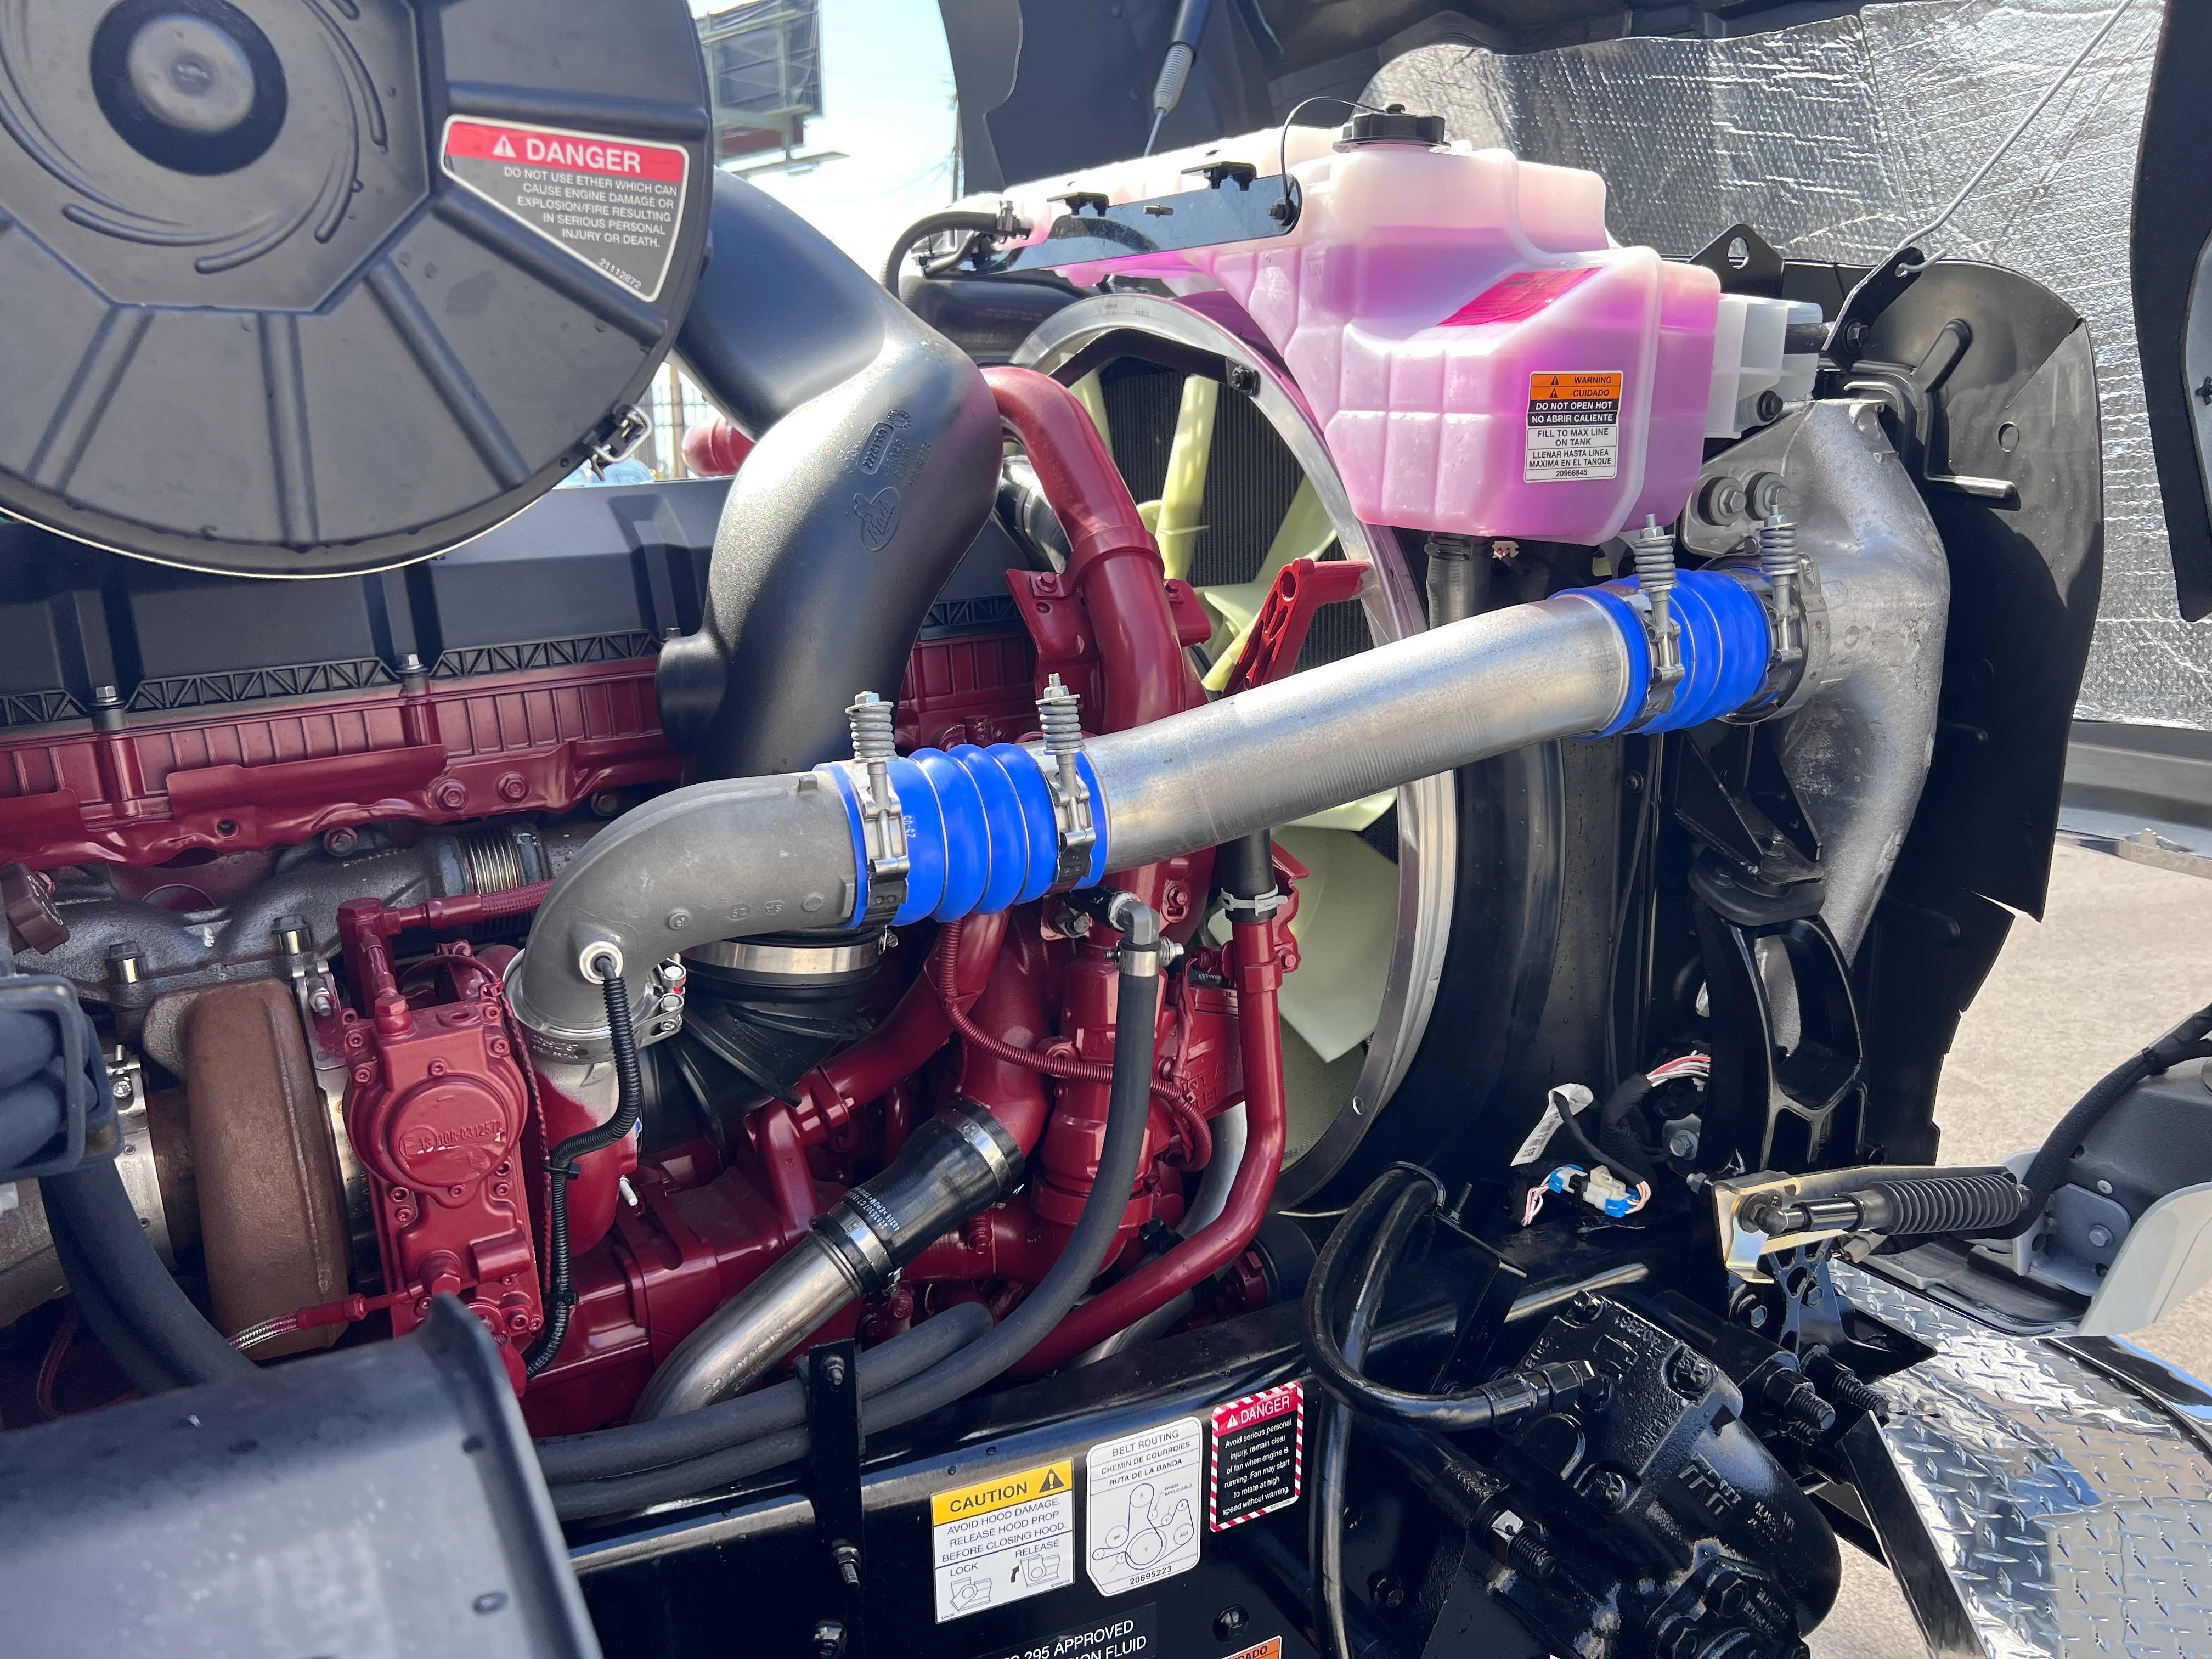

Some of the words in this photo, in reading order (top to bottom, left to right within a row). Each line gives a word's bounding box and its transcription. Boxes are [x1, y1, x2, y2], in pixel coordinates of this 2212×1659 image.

[526, 138, 641, 173] DANGER
[504, 167, 521, 178] DO
[524, 168, 548, 181] NOT
[551, 172, 572, 184] USE
[577, 175, 612, 189] ETHER
[616, 180, 652, 193] WHICH
[655, 184, 677, 195] CAN
[517, 196, 609, 214] EXPLOSION/FIRE
[613, 207, 671, 222] RESULTING
[523, 183, 561, 197] CAUSE
[565, 188, 606, 201] ENGINE
[609, 193, 656, 207] DAMAGE
[658, 199, 674, 209] OR
[543, 213, 554, 223] IN
[557, 216, 606, 229] SERIOUS
[608, 222, 665, 235] PERSONAL
[562, 228, 601, 241] INJURY
[604, 234, 620, 242] OR
[623, 235, 660, 247] DEATH.
[599, 258, 642, 290] 21112872
[1574, 414, 1612, 422] CALIENTE
[1240, 1396, 1290, 1424] DANGER
[1113, 1443, 1136, 1457] BELT
[1138, 1430, 1178, 1448] ROUTING
[1225, 1436, 1242, 1448] Avoid
[1244, 1430, 1265, 1441] serious
[1267, 1419, 1292, 1435] personal
[1231, 1449, 1248, 1460] injury,
[1250, 1441, 1269, 1453] remain
[1271, 1434, 1286, 1443] clear
[1102, 1460, 1131, 1475] CHEMIN
[1133, 1456, 1143, 1465] DE
[1146, 1442, 1190, 1460] COURROIES
[1109, 1475, 1130, 1486] RUTA
[1132, 1471, 1142, 1480] DE
[1144, 1468, 1154, 1476] LA
[1156, 1458, 1182, 1472] BANDA
[1234, 1464, 1244, 1472] fan
[1245, 1458, 1261, 1468] when
[1262, 1450, 1282, 1462] engine
[1224, 1475, 1249, 1488] running.
[1250, 1471, 1261, 1480] Fan
[1263, 1466, 1275, 1476] may
[1277, 1459, 1290, 1469] start
[1242, 1483, 1259, 1495] rotate
[1267, 1476, 1279, 1487] high
[950, 1482, 1028, 1513] CAUTION
[1165, 1483, 1193, 1496] APPLICABLE
[1223, 1502, 1241, 1515] speed
[1243, 1495, 1263, 1508] without
[1265, 1486, 1289, 1499] warning.
[947, 1520, 978, 1535] AVOID
[981, 1511, 1012, 1526] HOOD
[1015, 1498, 1060, 1516] DAMAGE.
[950, 1527, 996, 1547] RELEASE
[998, 1519, 1029, 1533] HOOD
[1032, 1511, 1059, 1525] PROP
[943, 1544, 984, 1562] BEFORE
[986, 1531, 1031, 1550] CLOSING
[1035, 1522, 1066, 1537] HOOD.
[1015, 1539, 1059, 1558] RELEASE
[950, 1562, 978, 1576] LOCK
[1130, 1566, 1172, 1585] 20895223
[1024, 1645, 1050, 1659] 295
[1054, 1620, 1133, 1656] APPROVED
[1105, 1635, 1147, 1658] FLUID
